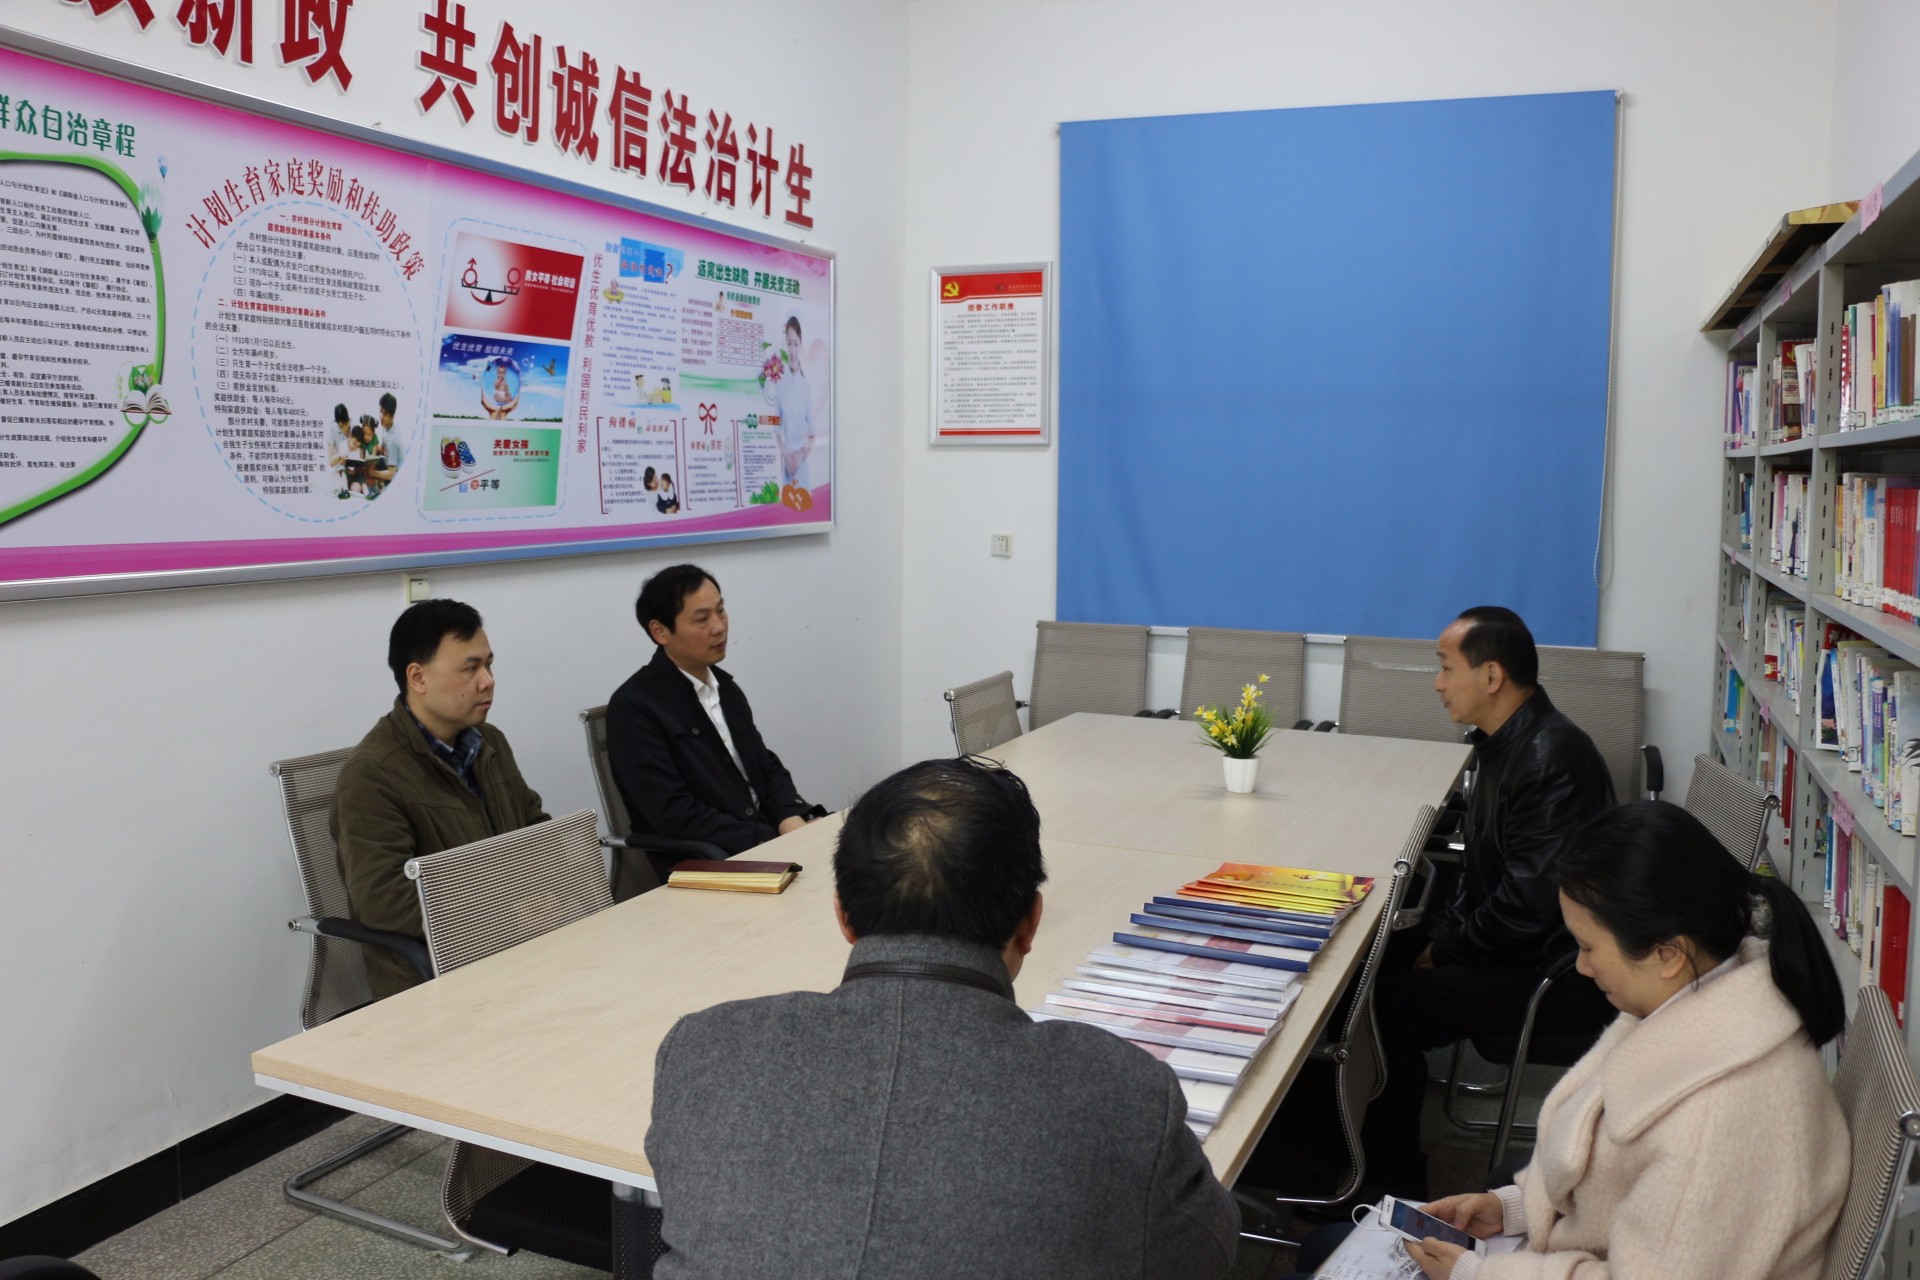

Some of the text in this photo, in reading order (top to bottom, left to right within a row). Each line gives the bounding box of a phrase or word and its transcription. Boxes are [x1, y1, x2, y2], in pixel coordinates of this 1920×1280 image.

[418, 0, 814, 229] 共创诚信法治计生
[185, 157, 426, 281] 计划生育家庭奖励和扶助政策
[697, 260, 749, 286] 远离出生缺陷
[754, 271, 801, 296] 开展关爱活动
[452, 342, 483, 353] 优生优育
[577, 253, 603, 454] 优生优育优教 利国利民利家
